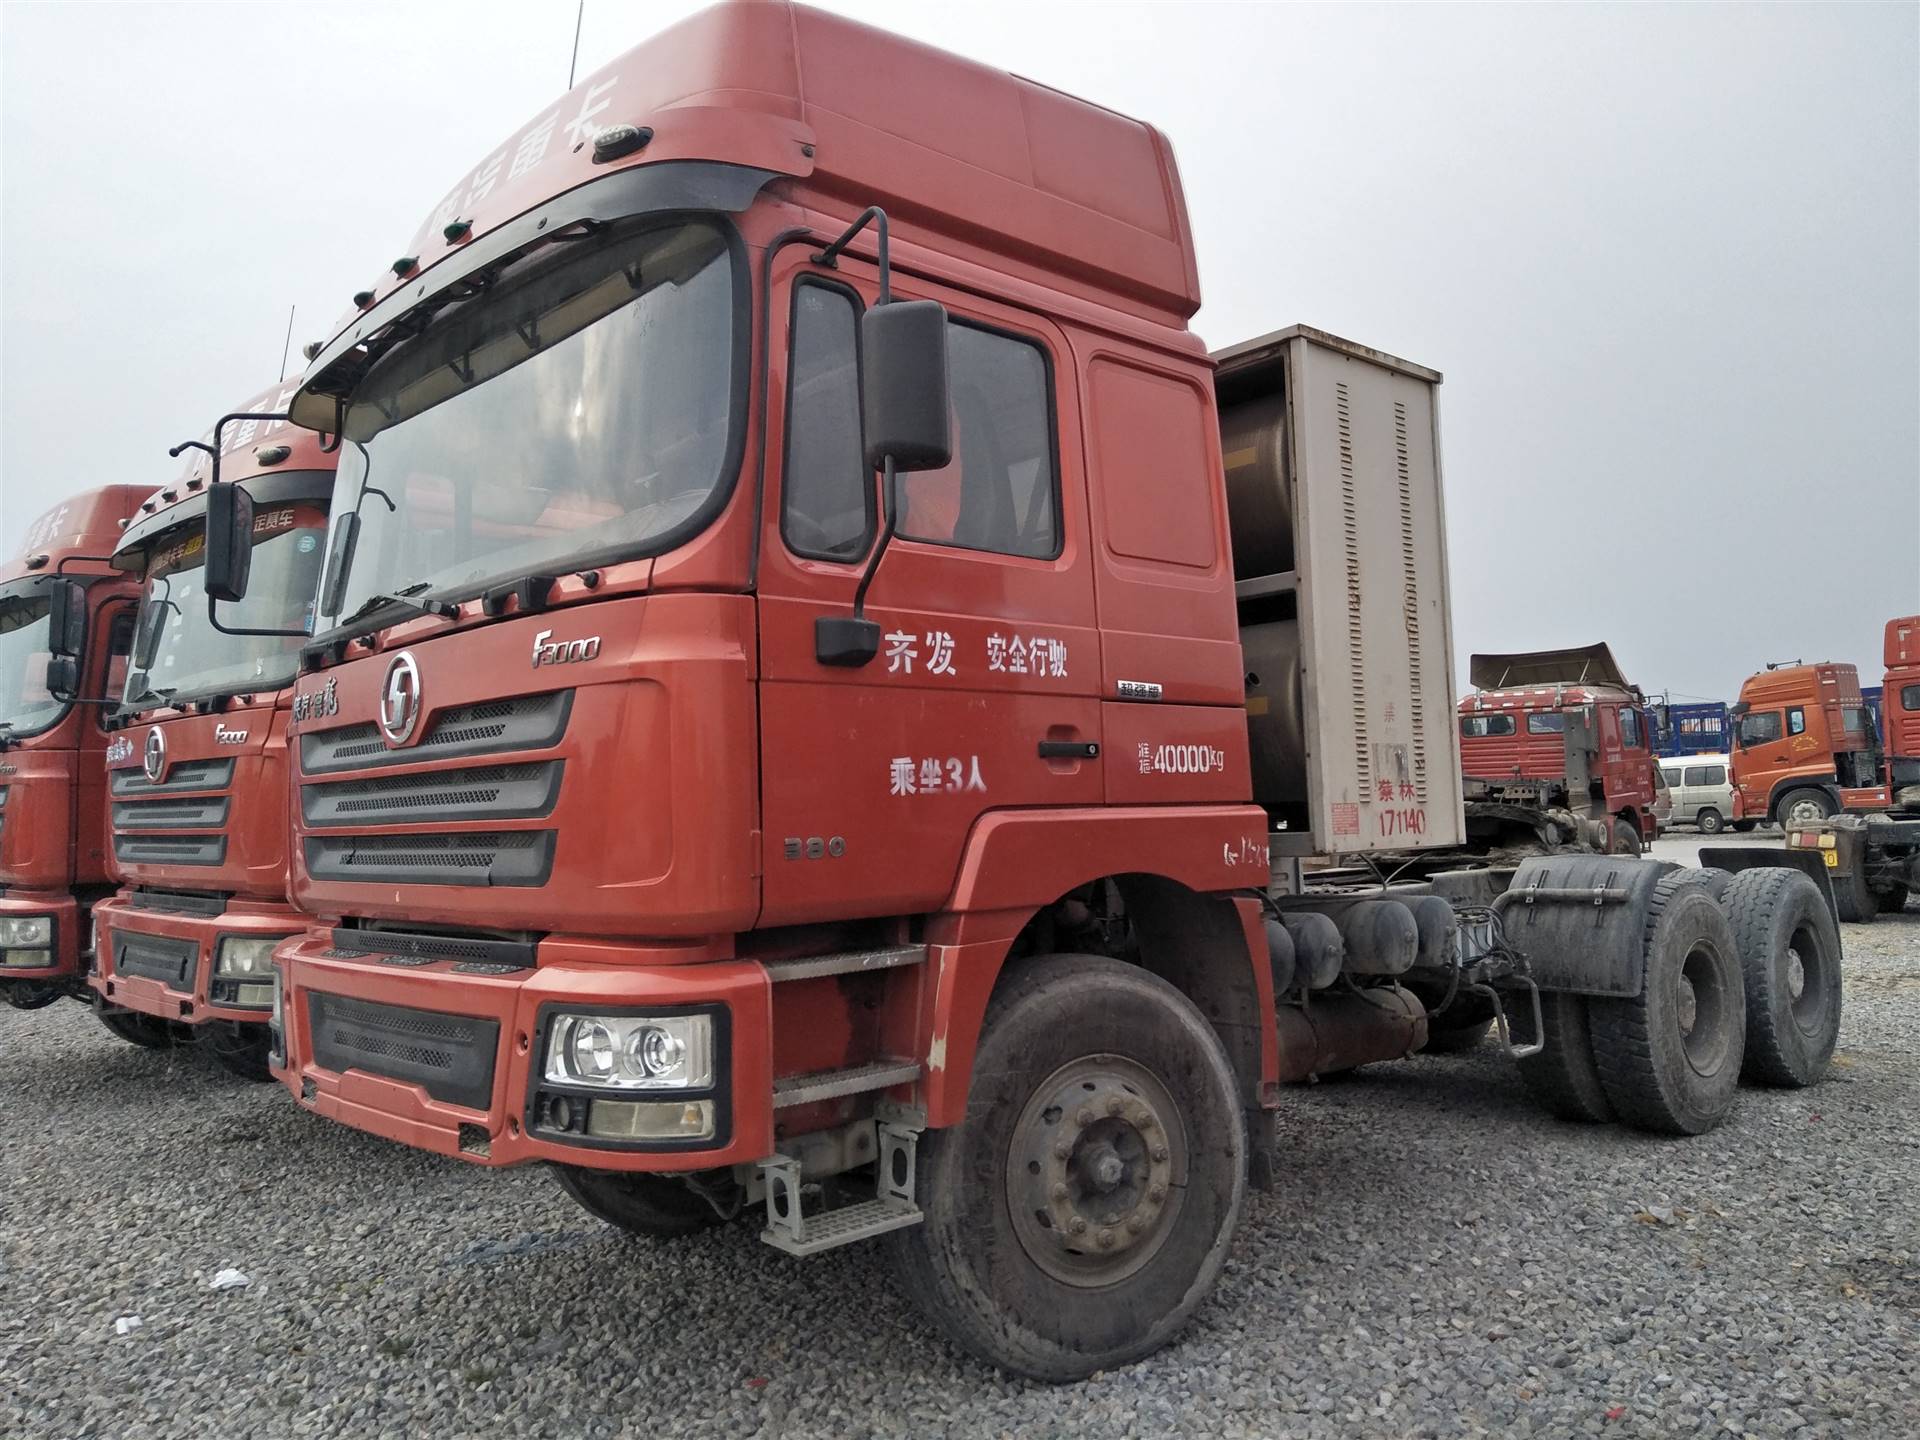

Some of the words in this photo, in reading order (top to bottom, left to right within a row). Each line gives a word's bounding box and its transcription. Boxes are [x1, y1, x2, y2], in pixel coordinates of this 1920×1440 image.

[532, 629, 601, 669] F3000
[884, 629, 956, 676] 齐发
[986, 632, 1068, 678] 安全行驶
[889, 755, 987, 796] 乘坐3人
[1379, 808, 1426, 836] 171140
